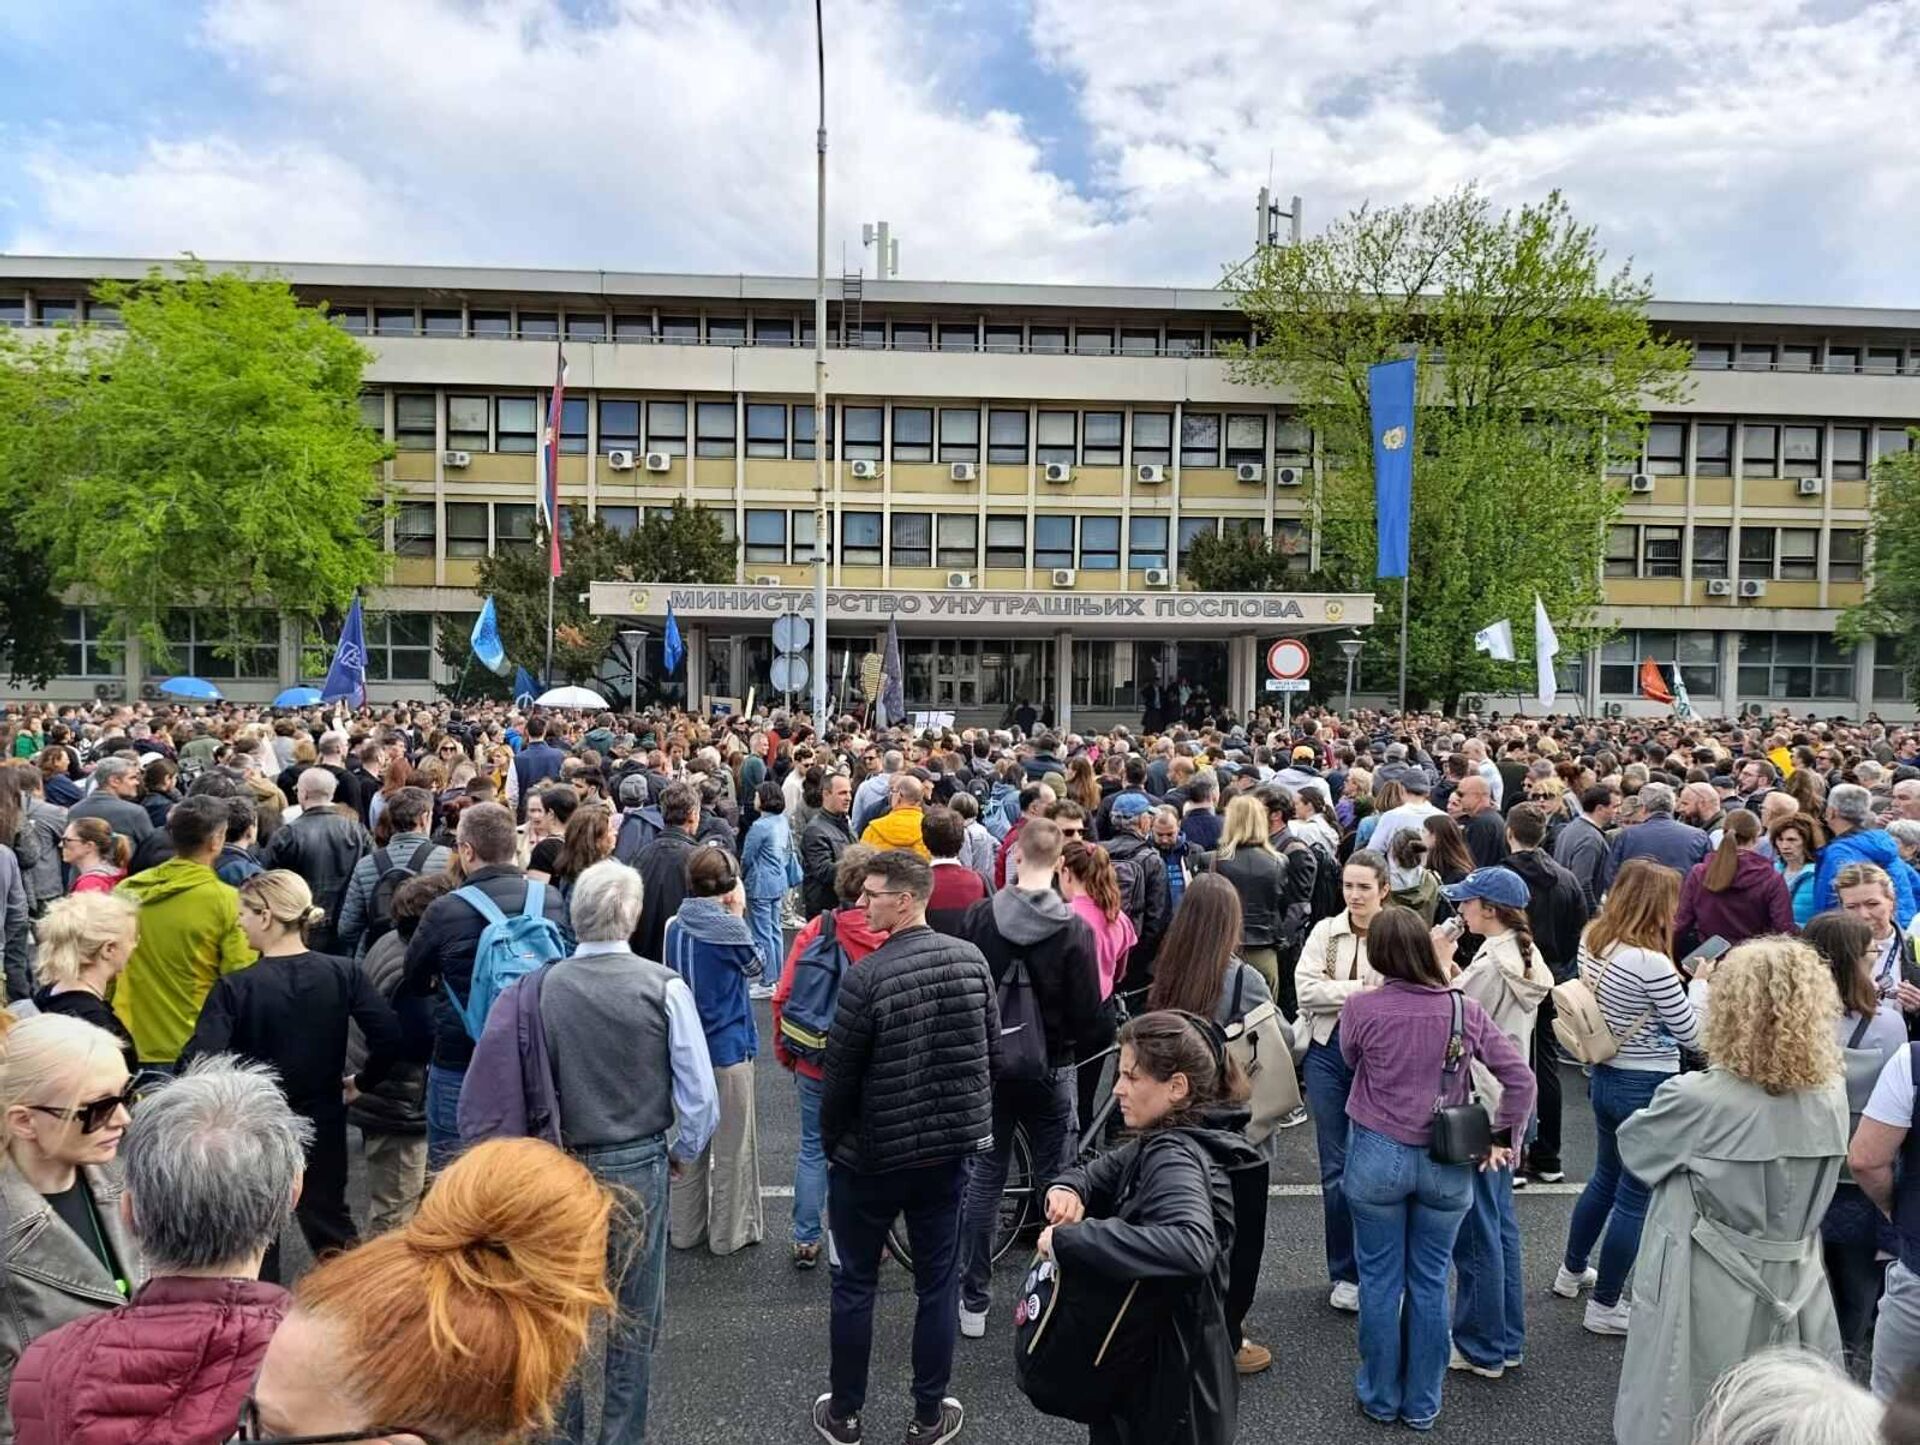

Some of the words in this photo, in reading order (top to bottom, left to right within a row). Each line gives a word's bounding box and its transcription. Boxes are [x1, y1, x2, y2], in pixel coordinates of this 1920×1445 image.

[670, 590, 922, 613] МИНИСТАРСТВО
[930, 595, 1145, 617] УНУТРАШЊИХ
[1156, 598, 1304, 618] ПОСЛОВА
